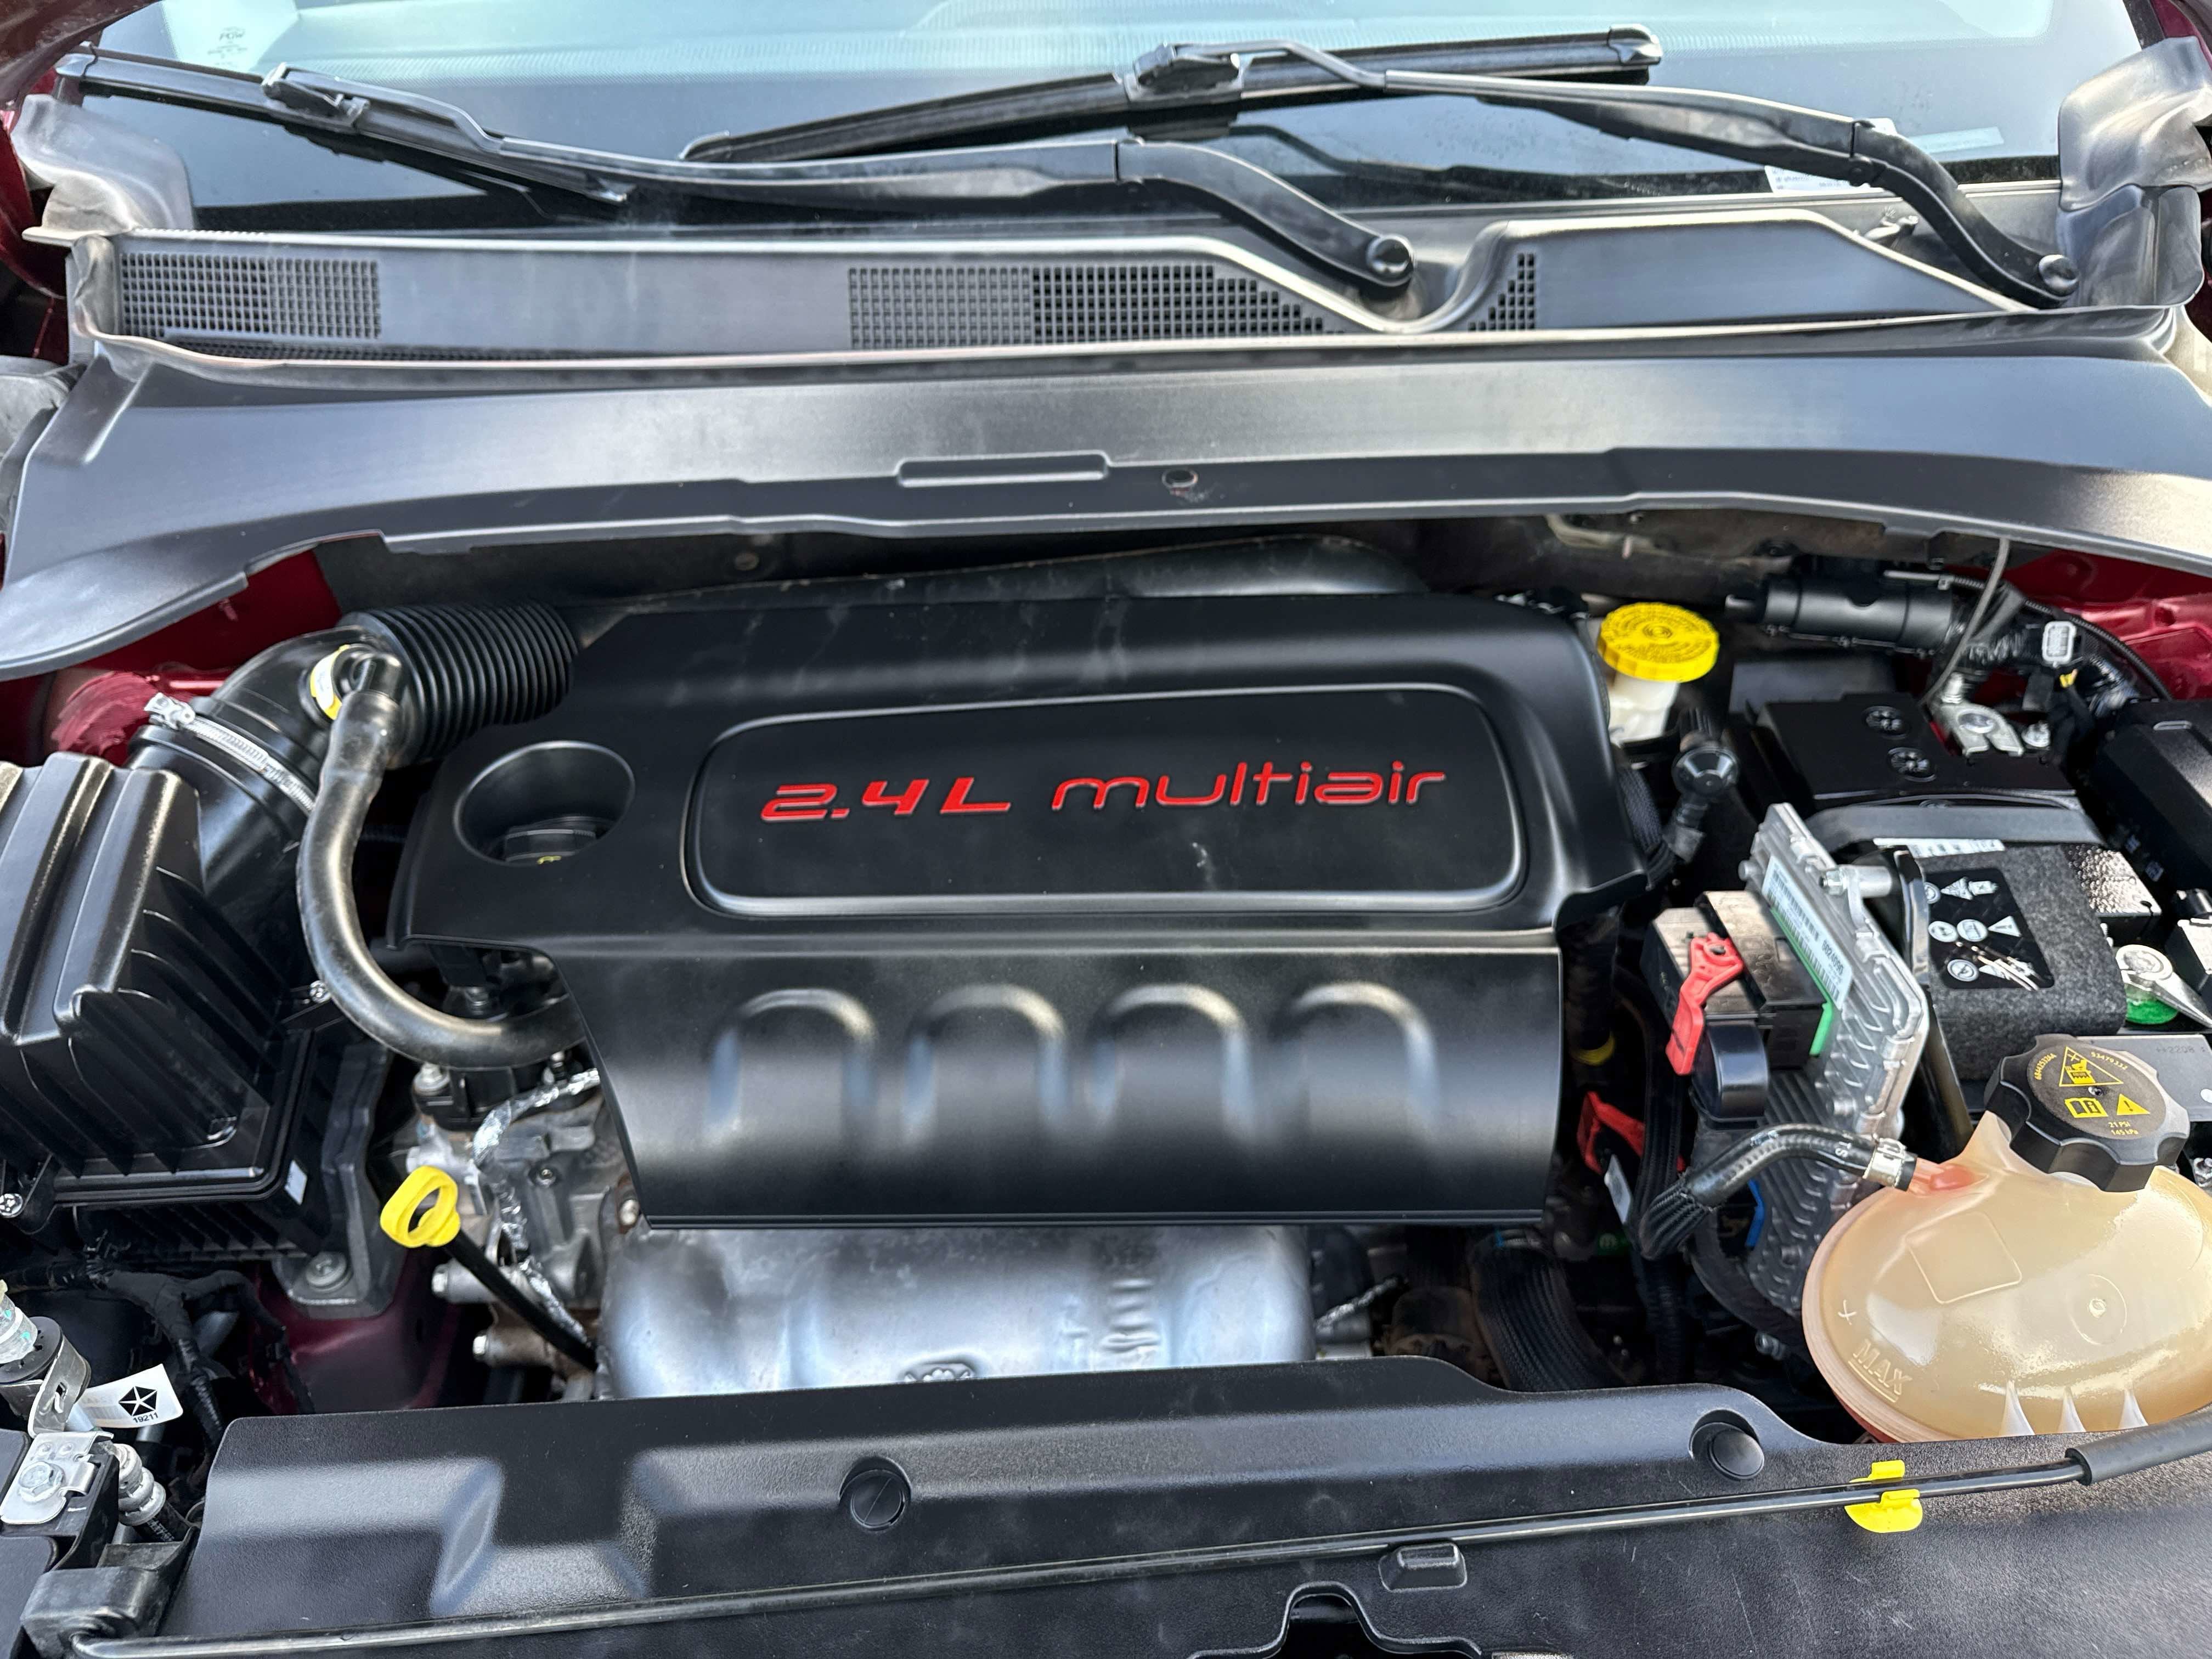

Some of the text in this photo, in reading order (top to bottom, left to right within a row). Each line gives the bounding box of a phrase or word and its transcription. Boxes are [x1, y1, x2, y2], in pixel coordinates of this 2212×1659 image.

[1051, 760, 1446, 811] multiair
[1852, 1339, 1912, 1395] MAX
[133, 1412, 159, 1423] 19211
